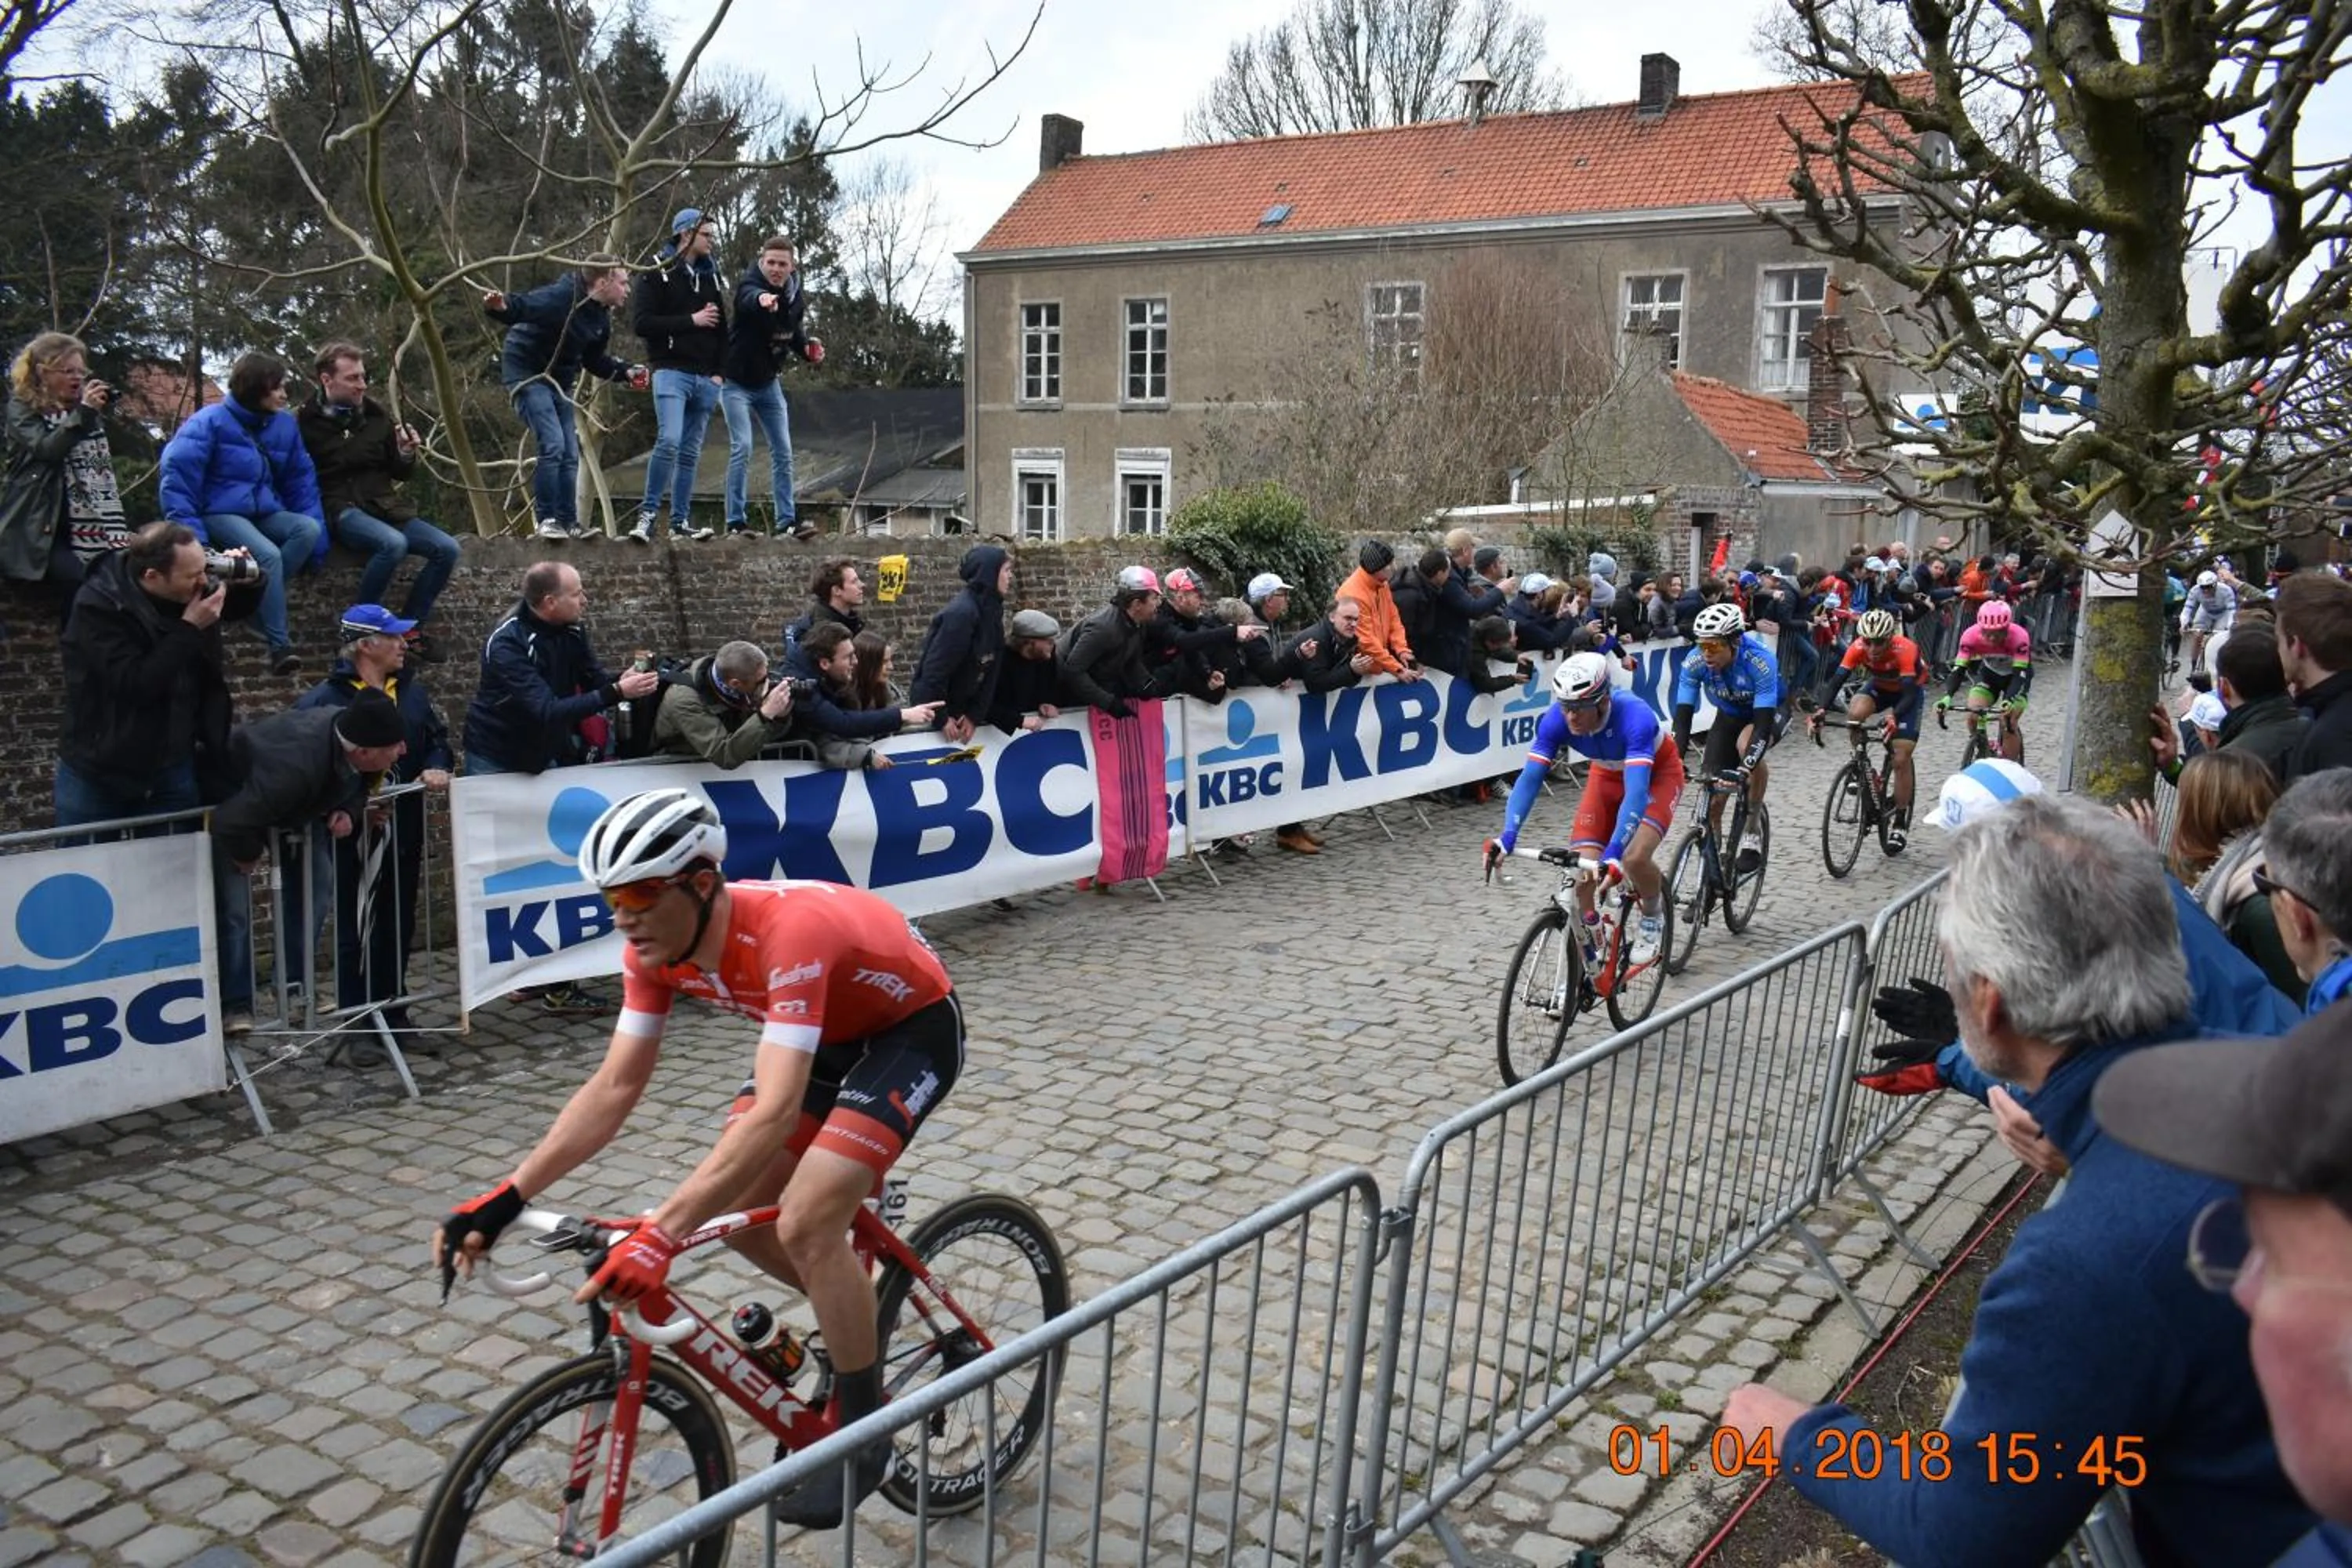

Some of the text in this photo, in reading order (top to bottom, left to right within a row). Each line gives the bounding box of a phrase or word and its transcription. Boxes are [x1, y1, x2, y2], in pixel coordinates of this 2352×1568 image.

[1298, 677, 1490, 790] KBC
[702, 728, 1094, 889] KBC
[1198, 760, 1283, 809] KBC
[485, 893, 615, 964] KB
[852, 968, 916, 1003] TREK
[884, 1178, 908, 1227] 161
